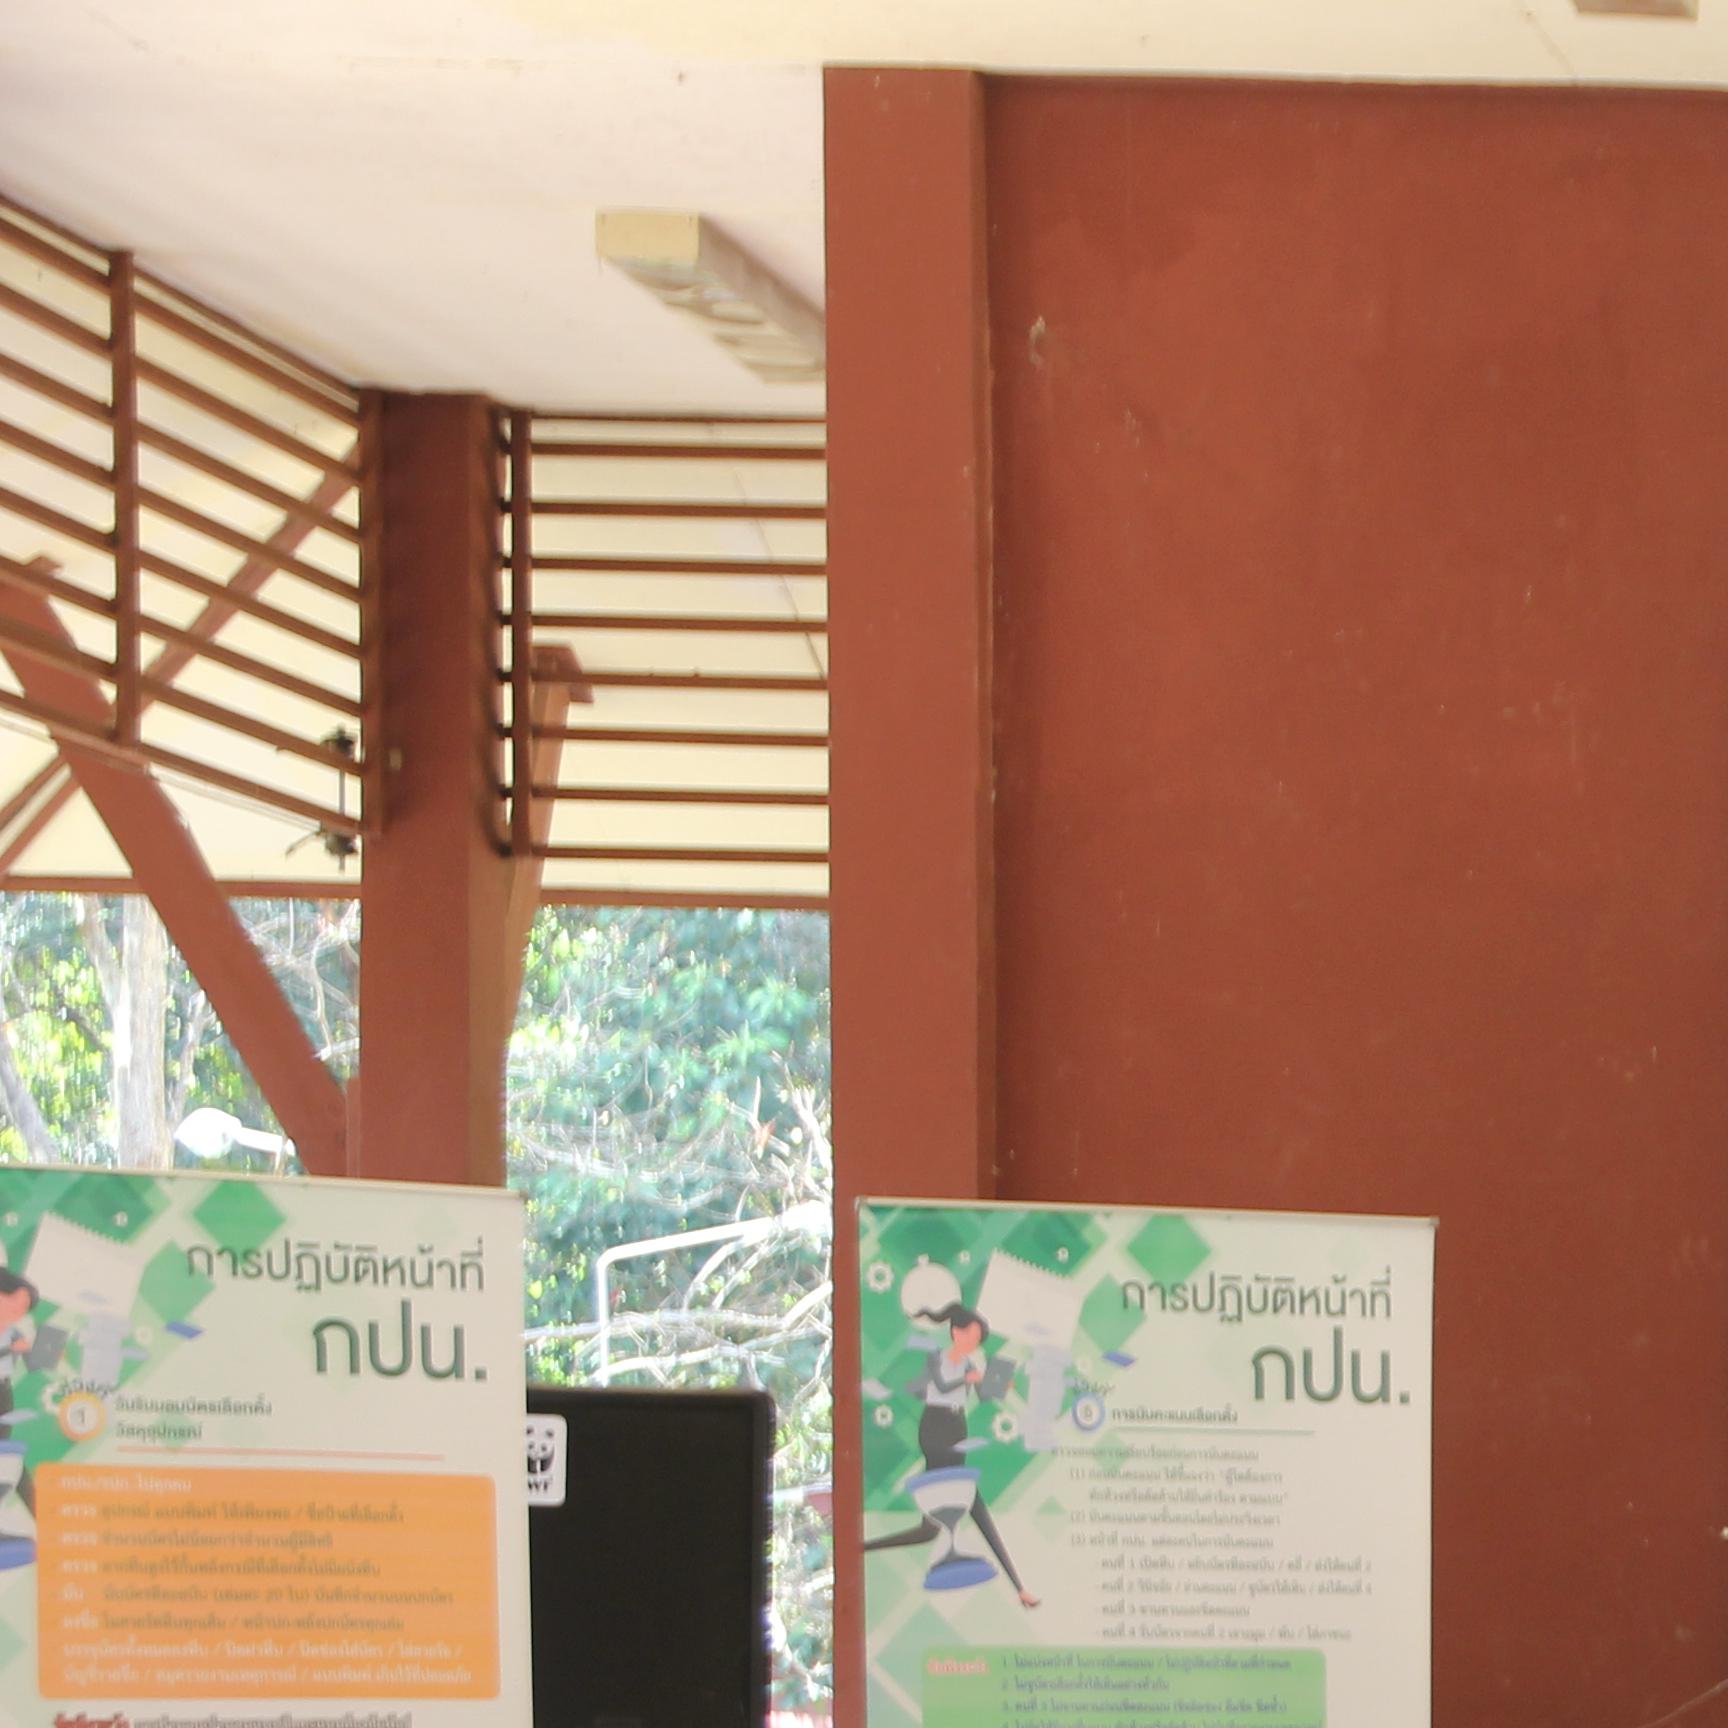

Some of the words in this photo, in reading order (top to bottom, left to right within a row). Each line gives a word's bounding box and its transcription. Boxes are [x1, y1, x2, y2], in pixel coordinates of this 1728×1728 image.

[186, 1236, 486, 1293] การปฏิบัติหน้าที่
[1121, 1265, 1393, 1323] การปฏิบัติหน้าที่
[312, 1298, 489, 1382] กปน.
[1250, 1325, 1412, 1404] กปน.
